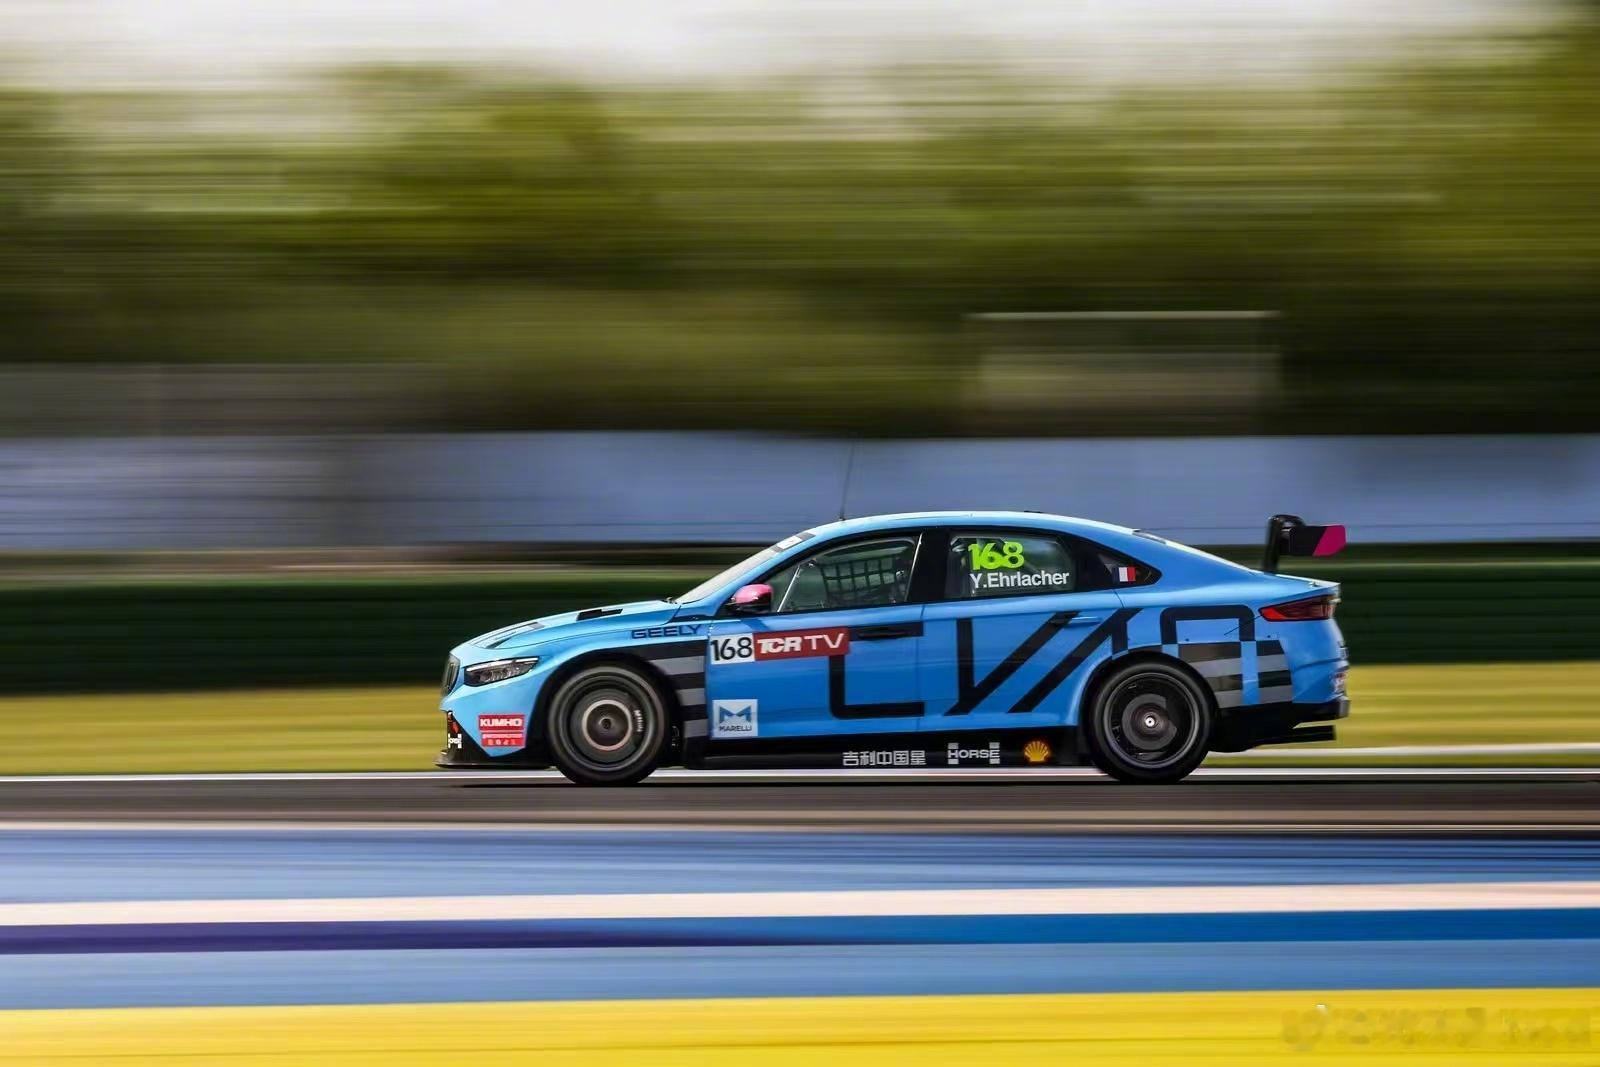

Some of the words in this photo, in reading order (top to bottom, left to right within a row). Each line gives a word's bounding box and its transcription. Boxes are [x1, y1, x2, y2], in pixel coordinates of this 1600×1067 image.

[968, 542, 1024, 570] 168
[970, 570, 1069, 589] Y.Ehrlacher
[631, 624, 700, 640] GEELY
[711, 636, 753, 661] 168
[757, 636, 803, 654] TCR
[804, 633, 845, 650] TV
[479, 718, 523, 727] KUMHO
[842, 750, 927, 766] 吉利中国星
[947, 746, 1000, 761] HORSE
